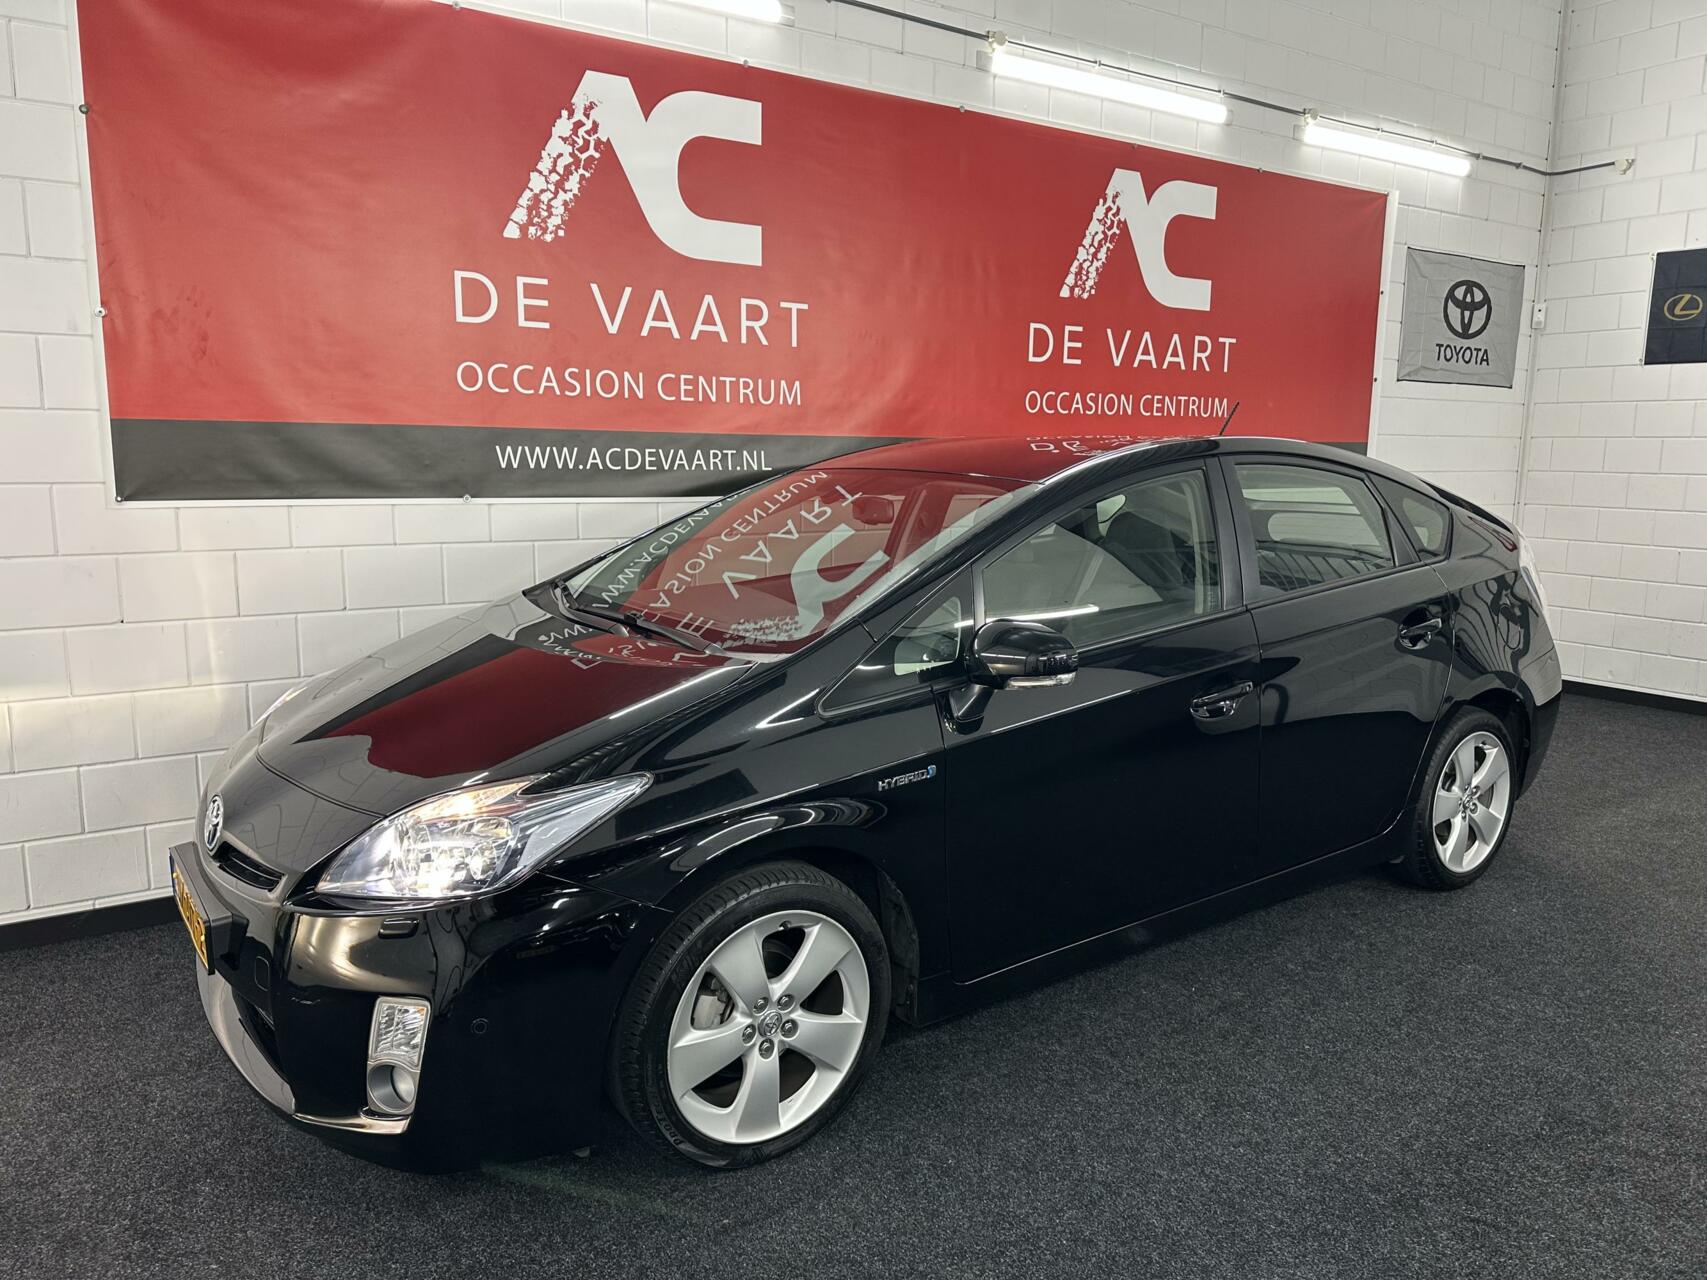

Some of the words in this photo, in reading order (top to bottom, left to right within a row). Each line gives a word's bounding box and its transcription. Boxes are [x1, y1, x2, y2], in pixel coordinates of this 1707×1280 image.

[503, 70, 762, 266] AC
[1059, 167, 1218, 311] AC
[453, 270, 550, 329] DE
[590, 283, 808, 348] VAART
[1027, 322, 1084, 365] DE
[1106, 328, 1237, 373] VAART
[1435, 343, 1490, 366] TOYOTA
[456, 361, 643, 400] OCCASION
[657, 373, 801, 406] CENTRUM
[1025, 390, 1133, 416] OCCASION
[1140, 395, 1228, 418] CENTRUM
[495, 445, 772, 471] WWW.ACDEVAART.NL
[878, 769, 928, 791] HYBRID
